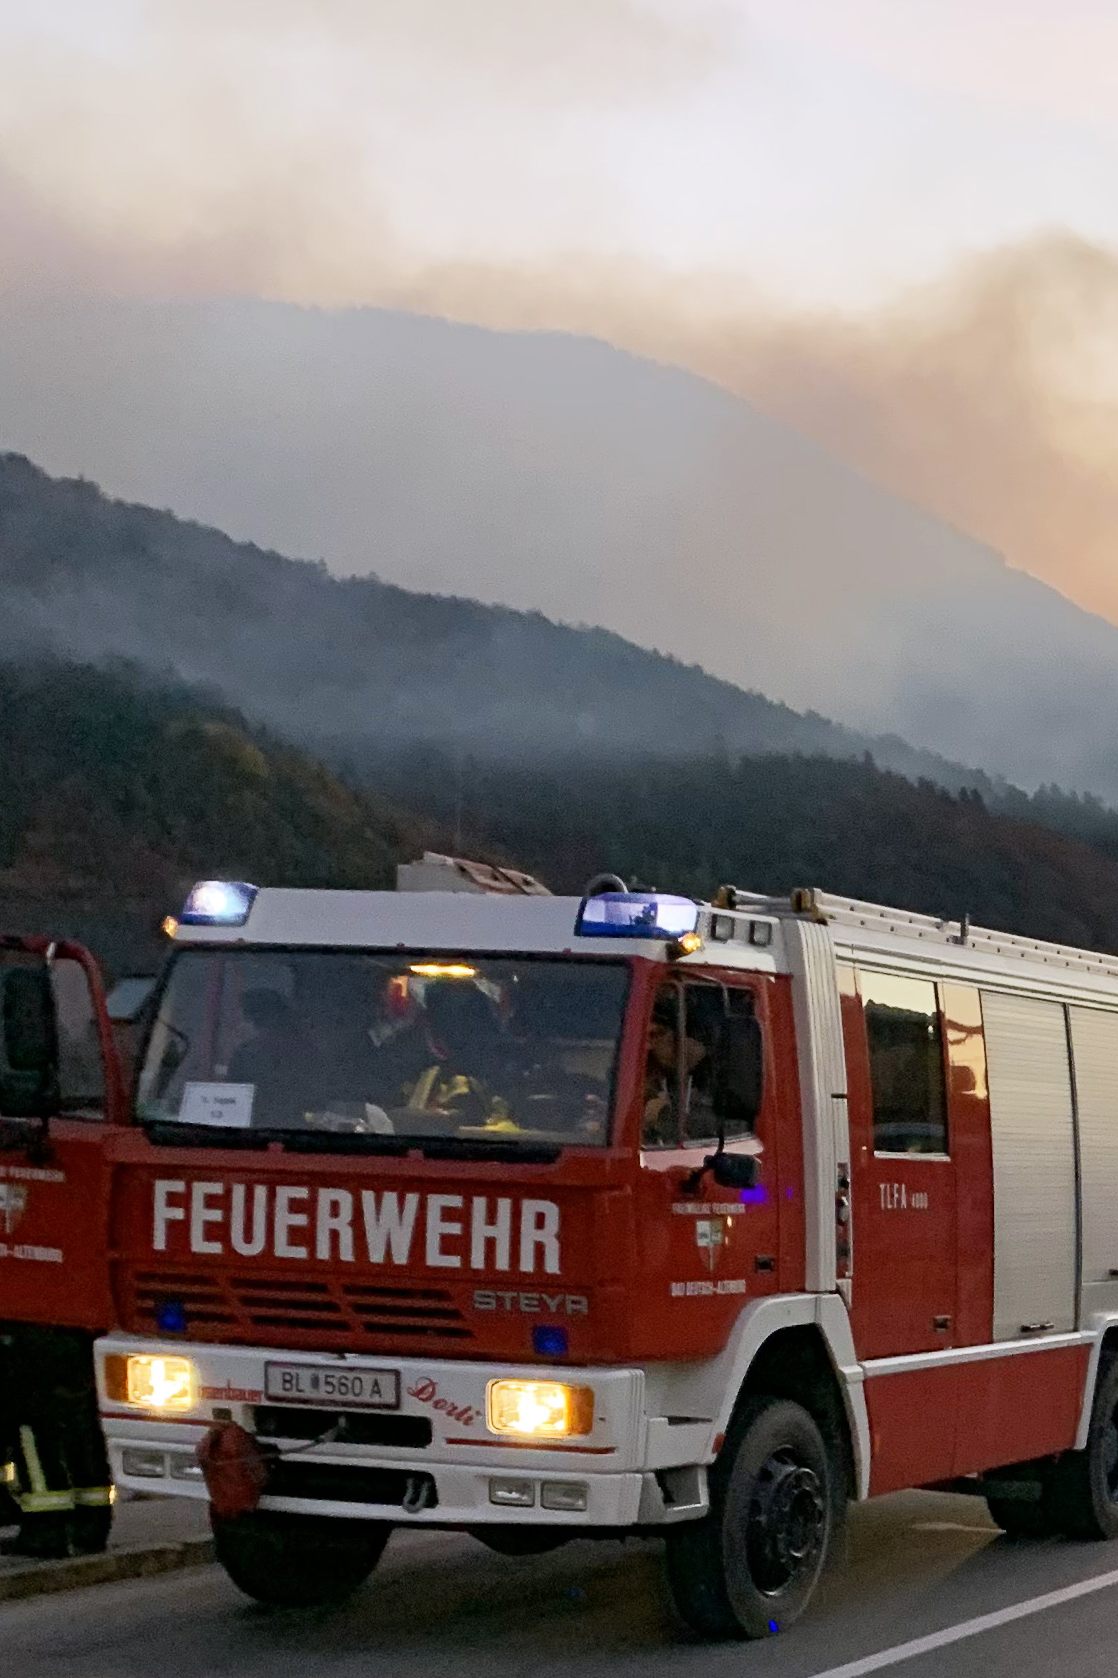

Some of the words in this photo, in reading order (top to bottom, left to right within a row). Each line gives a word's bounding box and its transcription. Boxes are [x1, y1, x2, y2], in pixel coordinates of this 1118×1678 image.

[880, 1183, 907, 1209] TLFA
[153, 1179, 560, 1274] FEUERWEHR
[474, 1290, 588, 1316] STEYR
[282, 1372, 305, 1393] BL
[324, 1374, 363, 1397] 560
[369, 1378, 382, 1398] A
